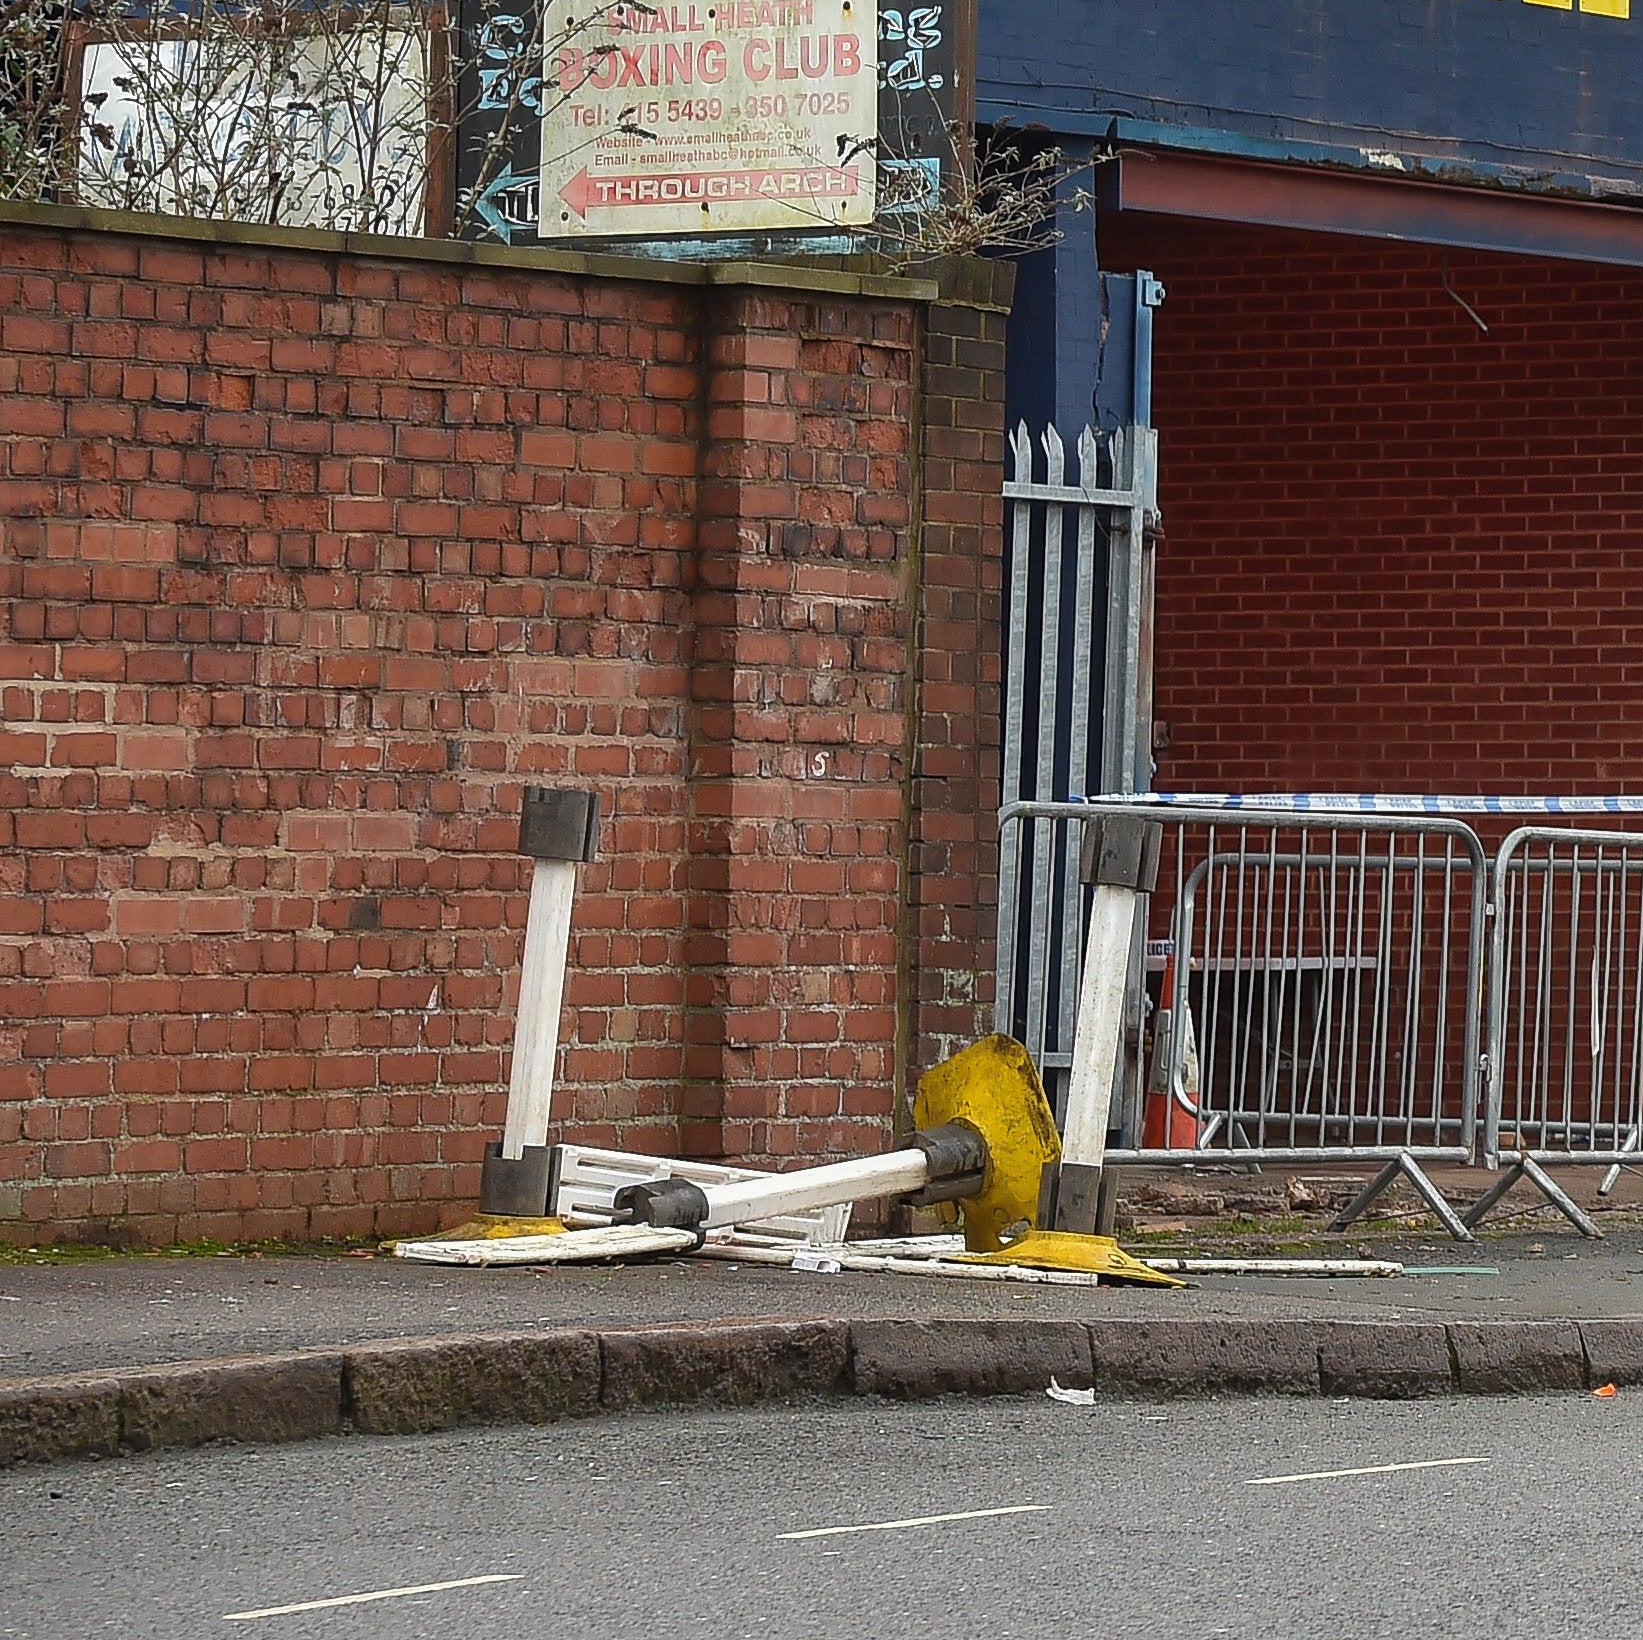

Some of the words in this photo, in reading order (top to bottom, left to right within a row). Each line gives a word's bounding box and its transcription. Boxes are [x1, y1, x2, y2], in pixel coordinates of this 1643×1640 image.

[607, 4, 705, 35] SMALL
[558, 40, 727, 90] BOXING
[742, 33, 861, 83] CLUB
[569, 104, 610, 128] Tel:
[667, 98, 723, 123] 5439
[794, 92, 851, 116] 7025
[595, 153, 628, 166] Email
[596, 175, 750, 203] THROUGH
[758, 172, 847, 194] ARCH
